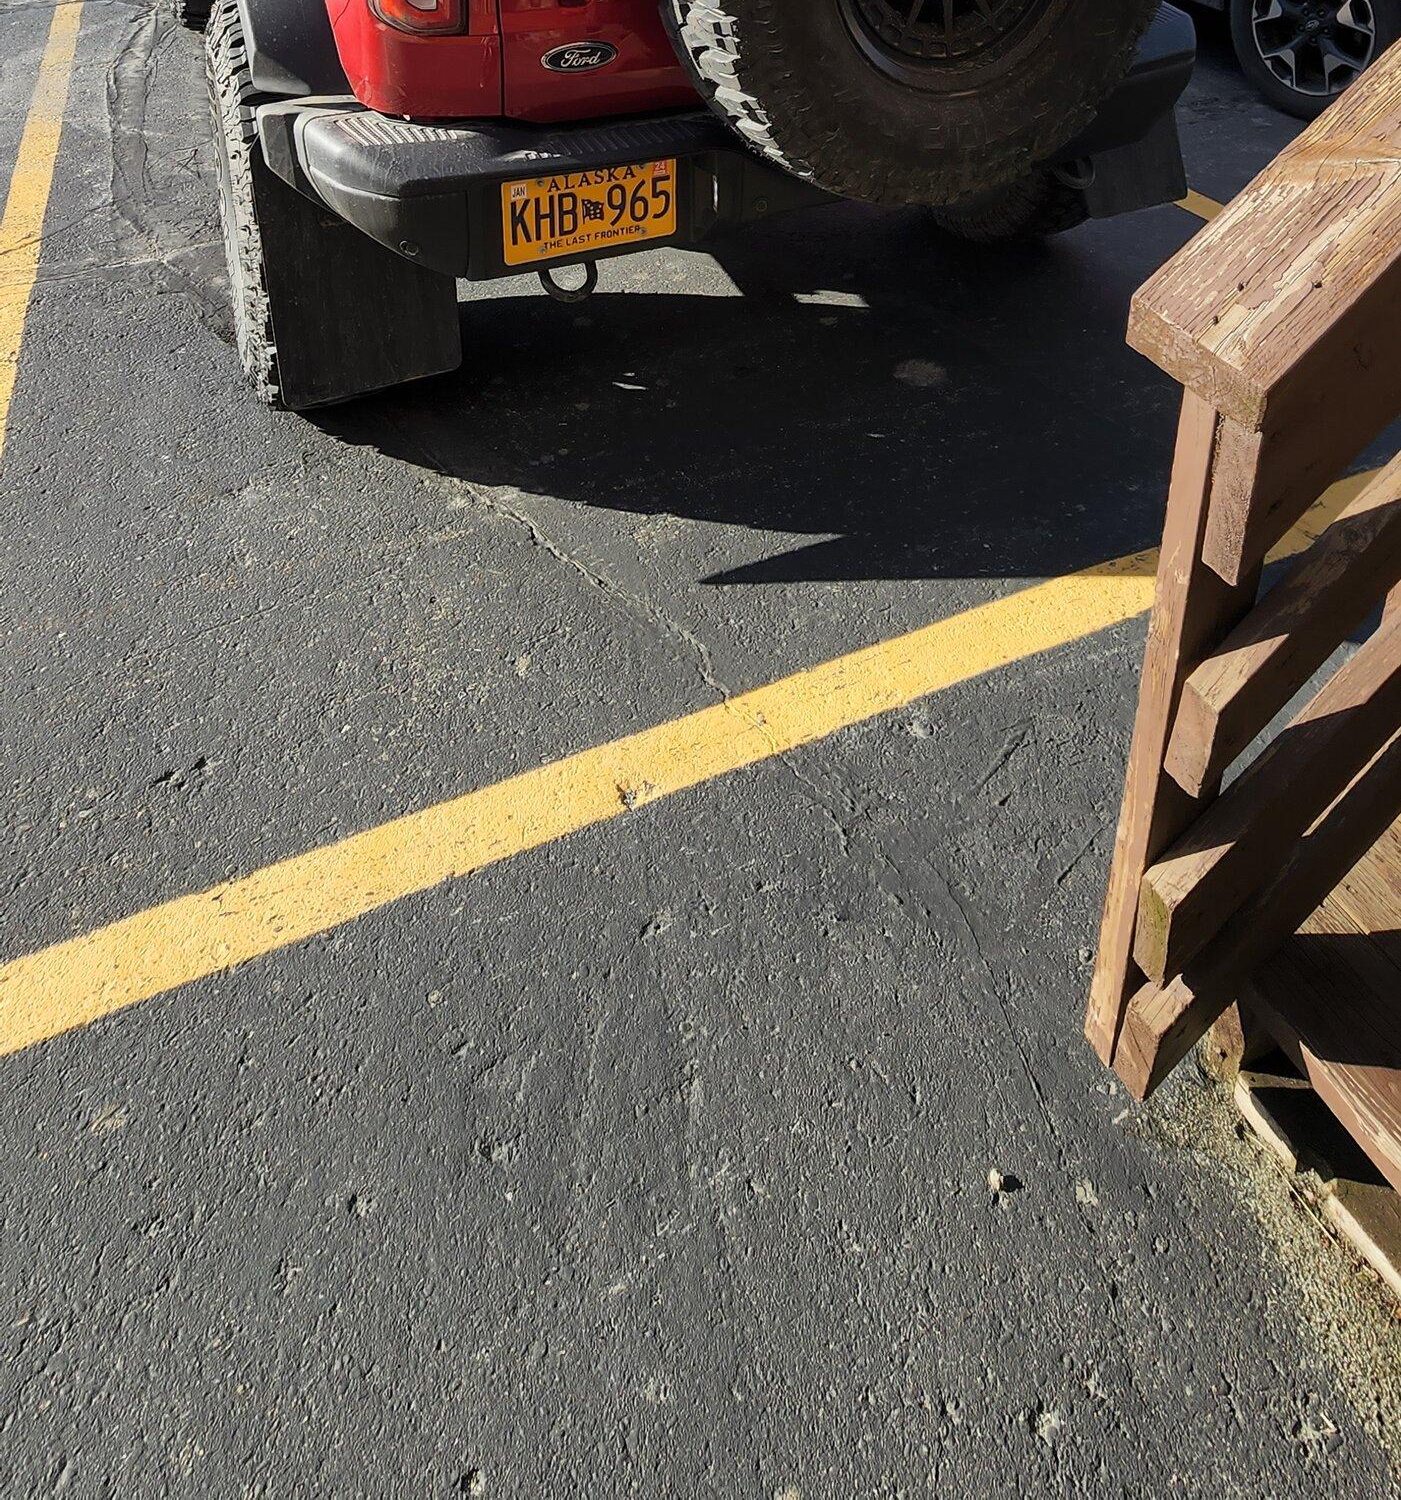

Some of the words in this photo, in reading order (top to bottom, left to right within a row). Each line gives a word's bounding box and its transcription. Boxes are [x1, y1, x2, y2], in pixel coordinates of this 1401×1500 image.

[560, 48, 601, 68] Ford
[547, 165, 636, 192] ALASKA
[512, 186, 526, 198] JAN
[510, 192, 578, 246] KHB
[607, 175, 671, 227] 965
[544, 240, 563, 251] THE
[566, 234, 591, 246] LAST
[594, 225, 641, 240] FRONTIER
